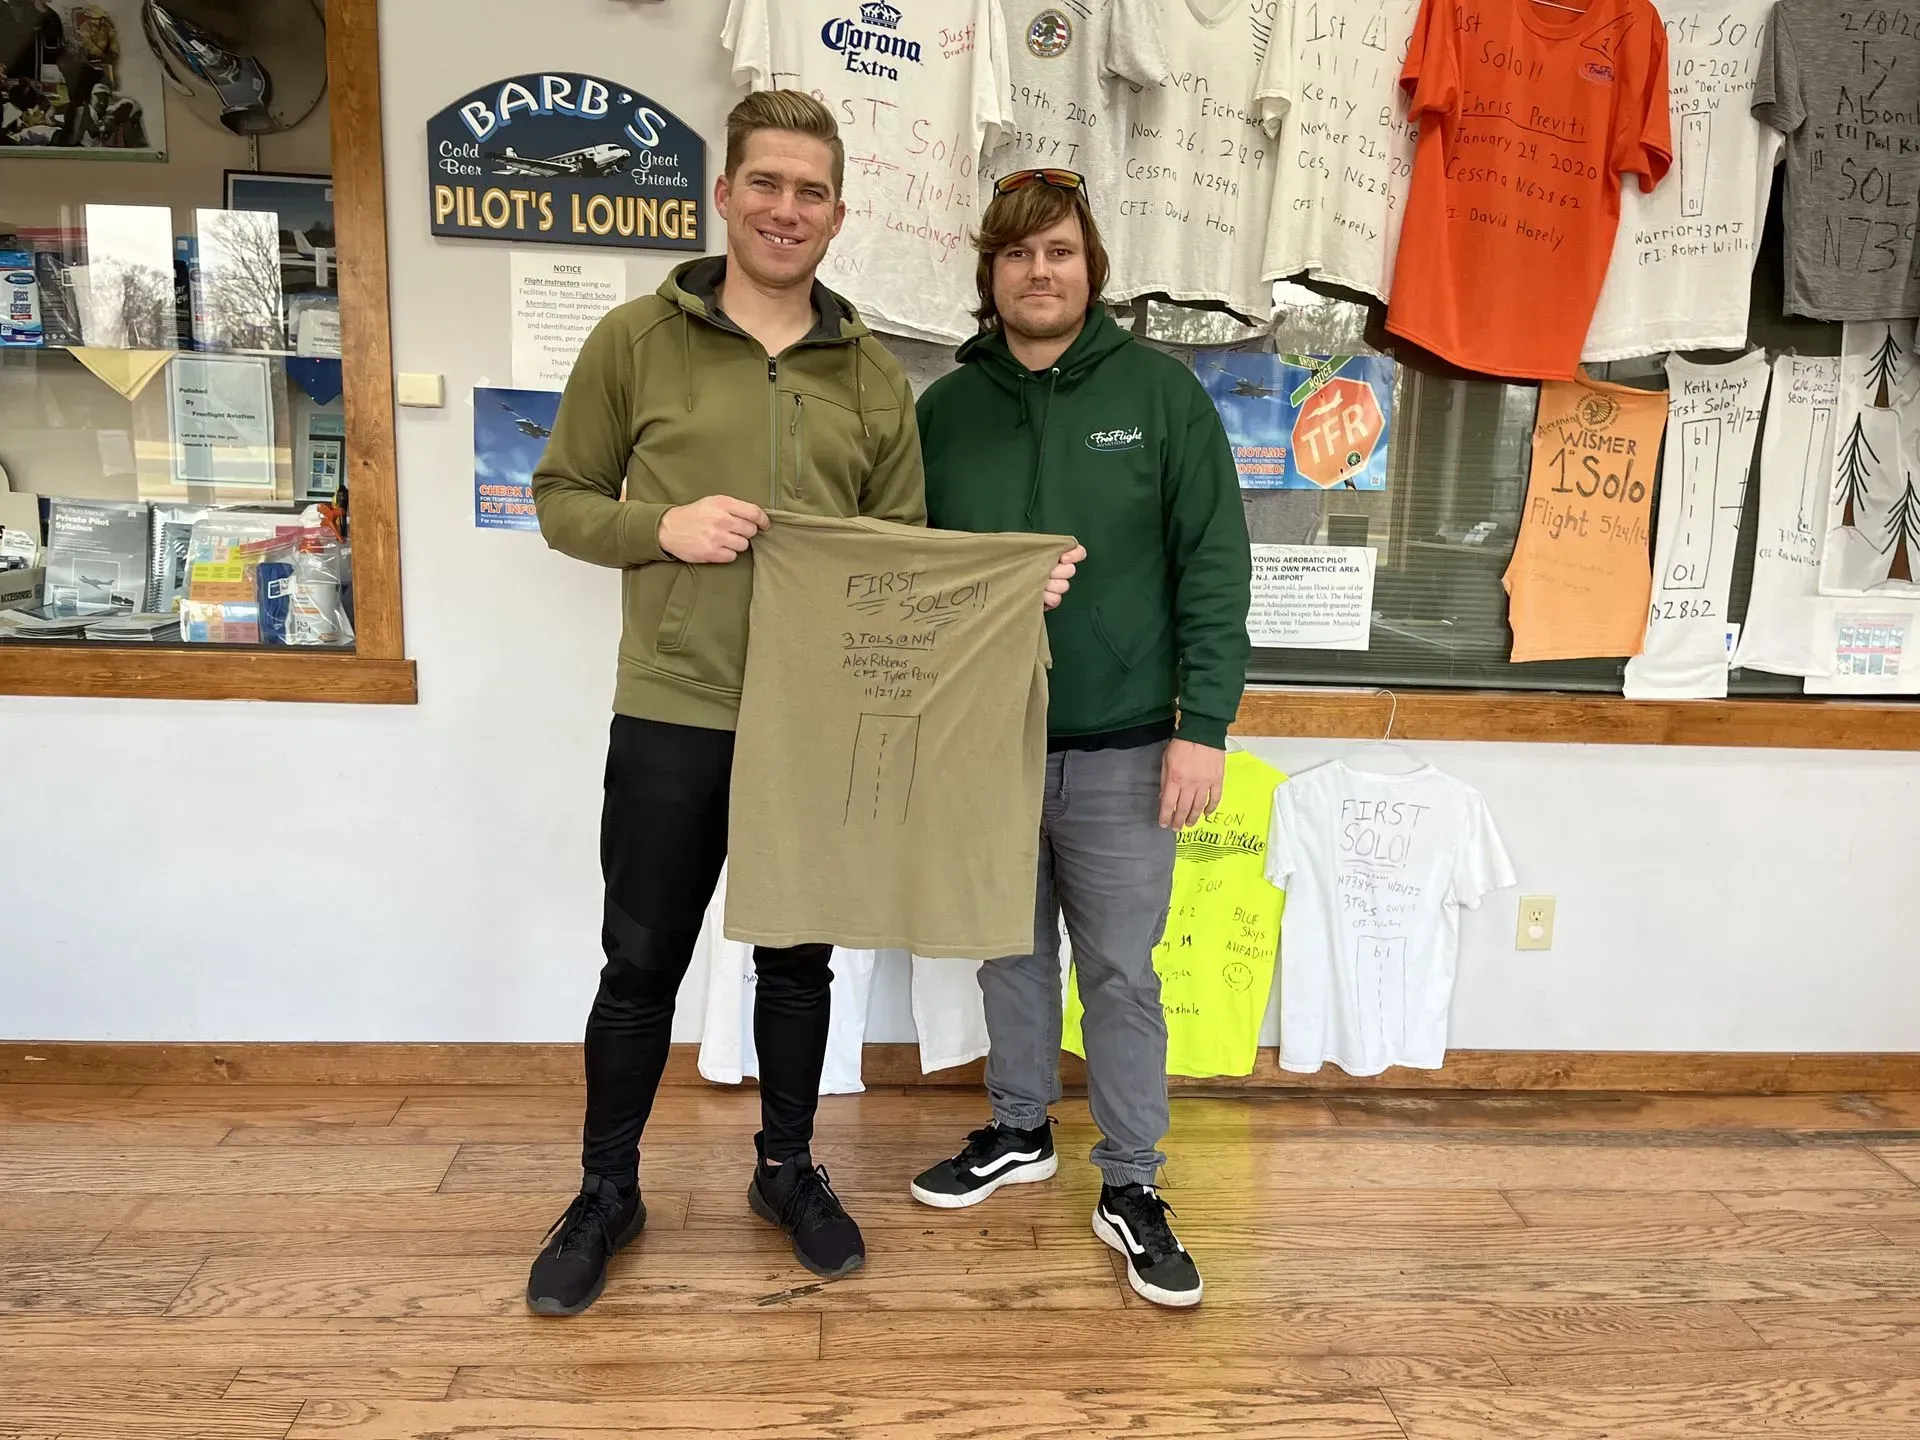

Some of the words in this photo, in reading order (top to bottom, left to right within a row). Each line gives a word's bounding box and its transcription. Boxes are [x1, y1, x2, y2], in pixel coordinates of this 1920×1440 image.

[821, 17, 923, 65] Corona
[845, 52, 898, 81] Extra
[1480, 40, 1543, 83] Solo!!
[458, 75, 667, 149] BARB'S
[1065, 102, 1097, 128] 2020
[1529, 105, 1586, 137] Previti
[1131, 122, 1163, 139] Nov.
[439, 140, 479, 159] Cold
[1454, 127, 1511, 149] January
[1550, 153, 1598, 180] 2020
[439, 159, 482, 176] Beer
[639, 150, 679, 169] Great
[631, 168, 688, 188] Friends
[1445, 157, 1507, 185] Cessna
[1516, 176, 1581, 210] N62862
[434, 184, 554, 231] PILOT'S
[571, 193, 698, 240] LOUNGE
[1470, 207, 1507, 229] David
[1516, 219, 1565, 252] Hopely
[553, 265, 582, 273] NOTICE
[519, 288, 547, 297] Facilities
[524, 277, 543, 287] Flight
[544, 279, 580, 288] Instructors
[581, 281, 598, 289] using
[526, 300, 557, 308] Members
[577, 303, 601, 311] provide
[545, 312, 580, 321] Citizenship
[527, 322, 539, 330] and
[541, 323, 584, 331] Identification
[551, 359, 571, 367] Thank
[1299, 356, 1319, 370] SHORT
[1308, 364, 1334, 390] NOTICE
[1684, 379, 1712, 395] Keith
[1301, 403, 1369, 464] TFR
[1558, 426, 1637, 457] WISMER
[1237, 446, 1287, 458] NOTAMS
[1576, 455, 1646, 503] Solo
[479, 484, 523, 497] CHECK
[480, 502, 503, 513] FLY
[55, 514, 87, 524] Private
[89, 516, 110, 527] Pilot
[55, 521, 93, 533] Syllabus
[1529, 497, 1589, 539] Flight
[1253, 556, 1281, 564] YOUNG
[1283, 556, 1325, 564] AEROBATIC
[846, 571, 927, 598] FIRST
[899, 581, 989, 622] SOLO!!
[843, 653, 867, 668] Alex
[883, 671, 908, 684] Tyler
[912, 666, 939, 687] Perry
[1341, 799, 1430, 827] FIRST
[1340, 822, 1411, 868] SOLO!
[1233, 907, 1259, 926] BLUE
